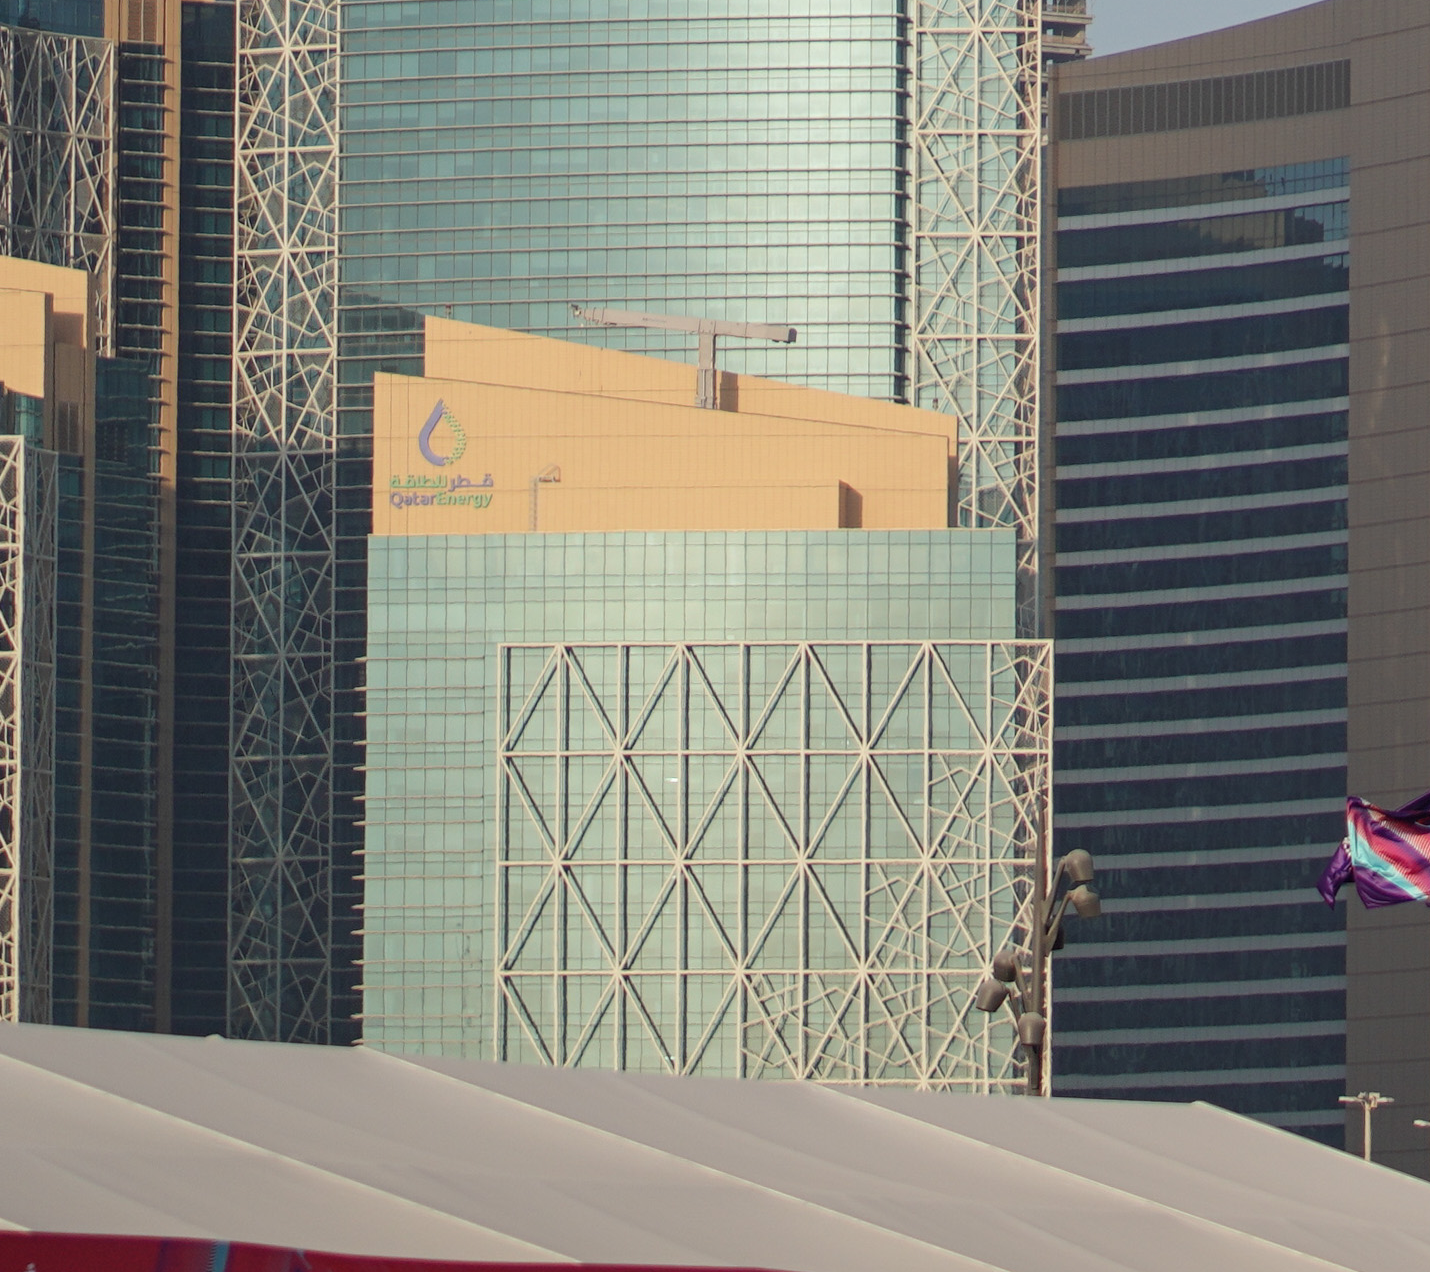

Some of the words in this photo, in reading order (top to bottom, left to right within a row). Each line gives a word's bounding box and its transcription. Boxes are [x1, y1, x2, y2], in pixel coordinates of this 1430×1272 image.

[390, 474, 447, 489] للطاقة
[448, 473, 494, 492] قطر
[390, 492, 493, 508] QatarEnergy
